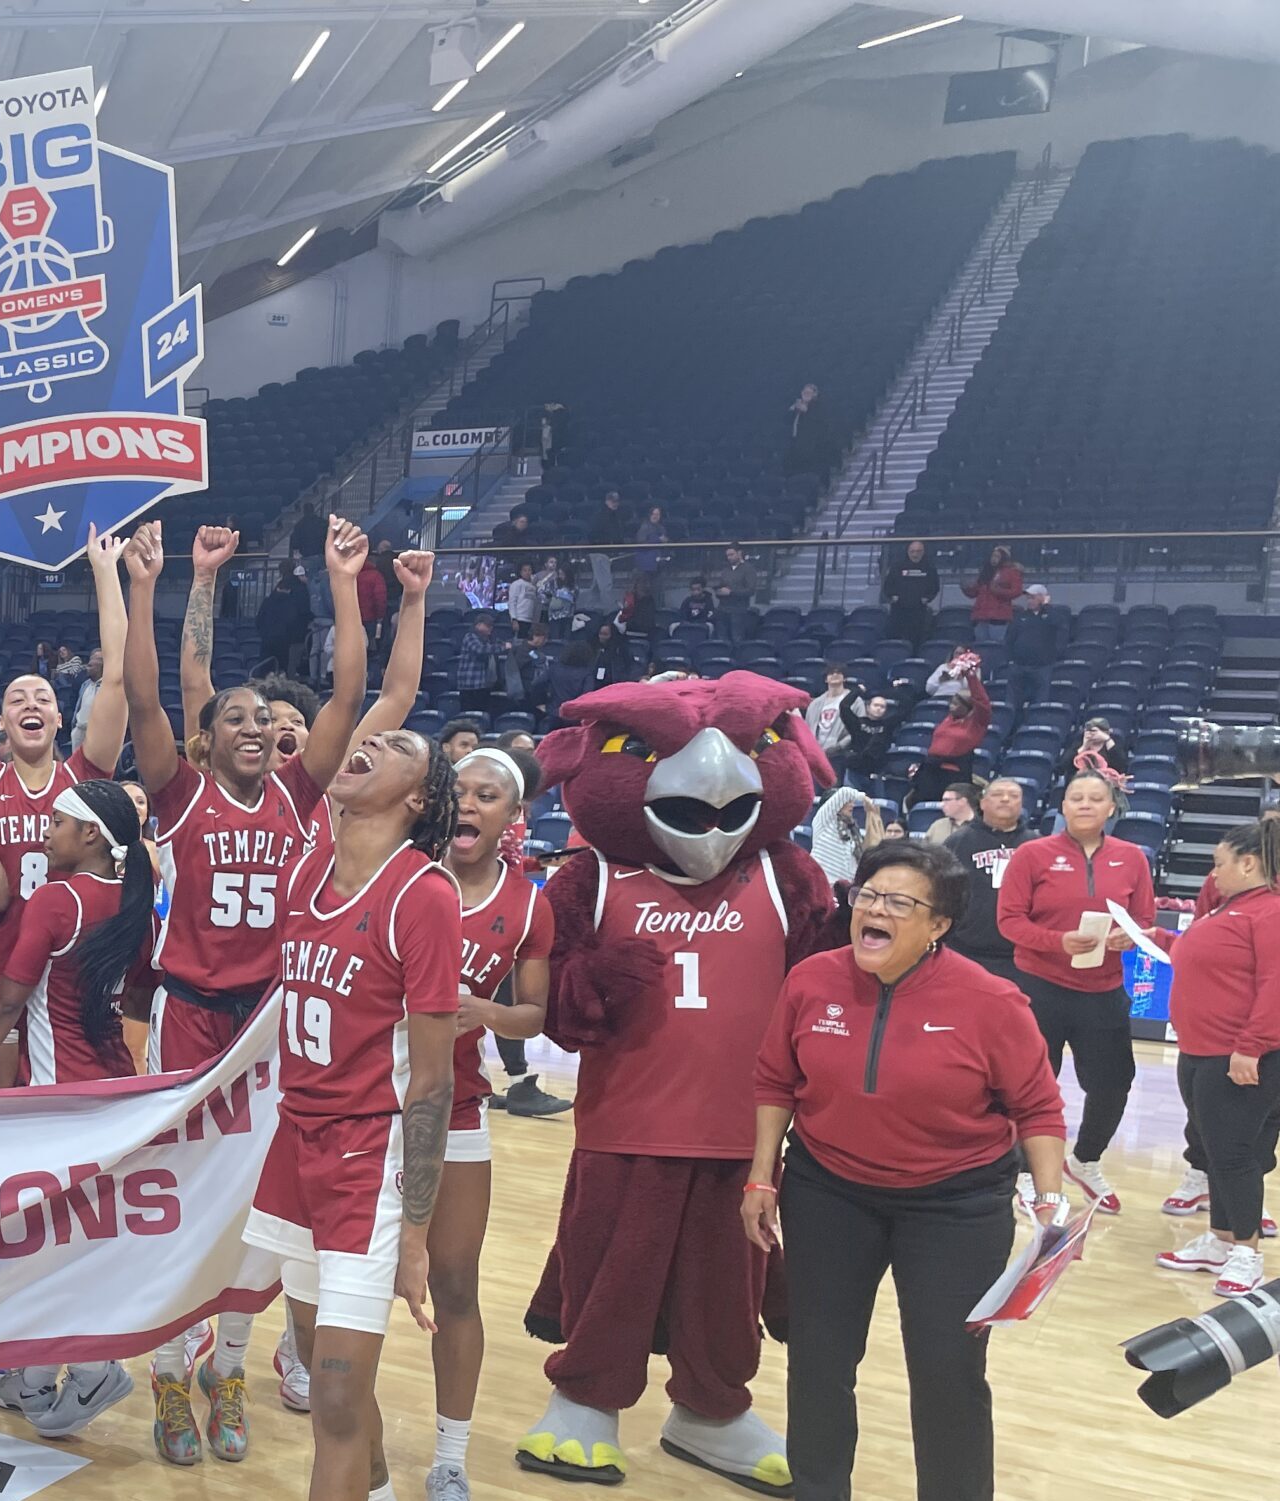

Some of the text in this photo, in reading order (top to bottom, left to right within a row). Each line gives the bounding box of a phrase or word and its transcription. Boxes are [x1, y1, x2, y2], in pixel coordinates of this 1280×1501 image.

[12, 200, 37, 226] 5
[157, 319, 190, 361] 24
[203, 830, 293, 867] TEMPLE
[20, 852, 48, 900] 8
[210, 872, 278, 929] 55
[634, 900, 744, 942] Temple
[282, 940, 364, 998] EMPLE
[674, 952, 707, 1009] 1
[285, 990, 332, 1067] 19
